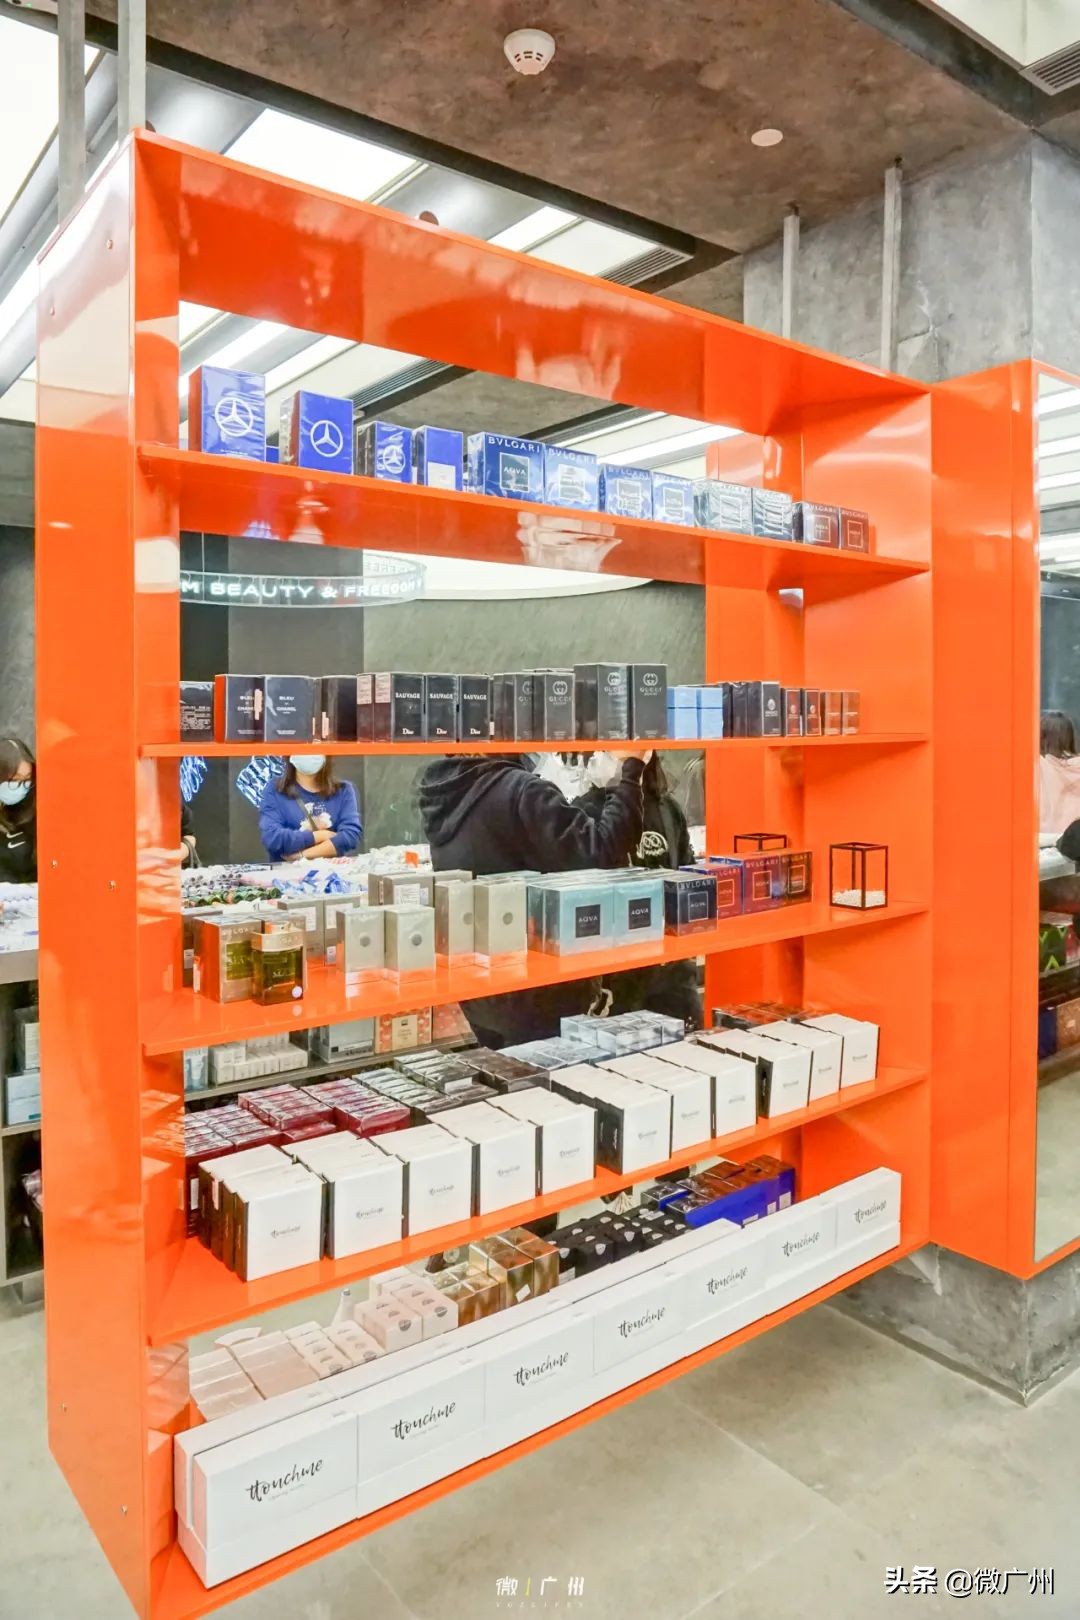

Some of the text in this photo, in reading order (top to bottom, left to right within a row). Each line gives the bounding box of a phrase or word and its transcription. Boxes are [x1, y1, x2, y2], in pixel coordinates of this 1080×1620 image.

[488, 435, 541, 453] BVLGARI
[210, 581, 315, 598] BEAUTY
[321, 586, 338, 599] &
